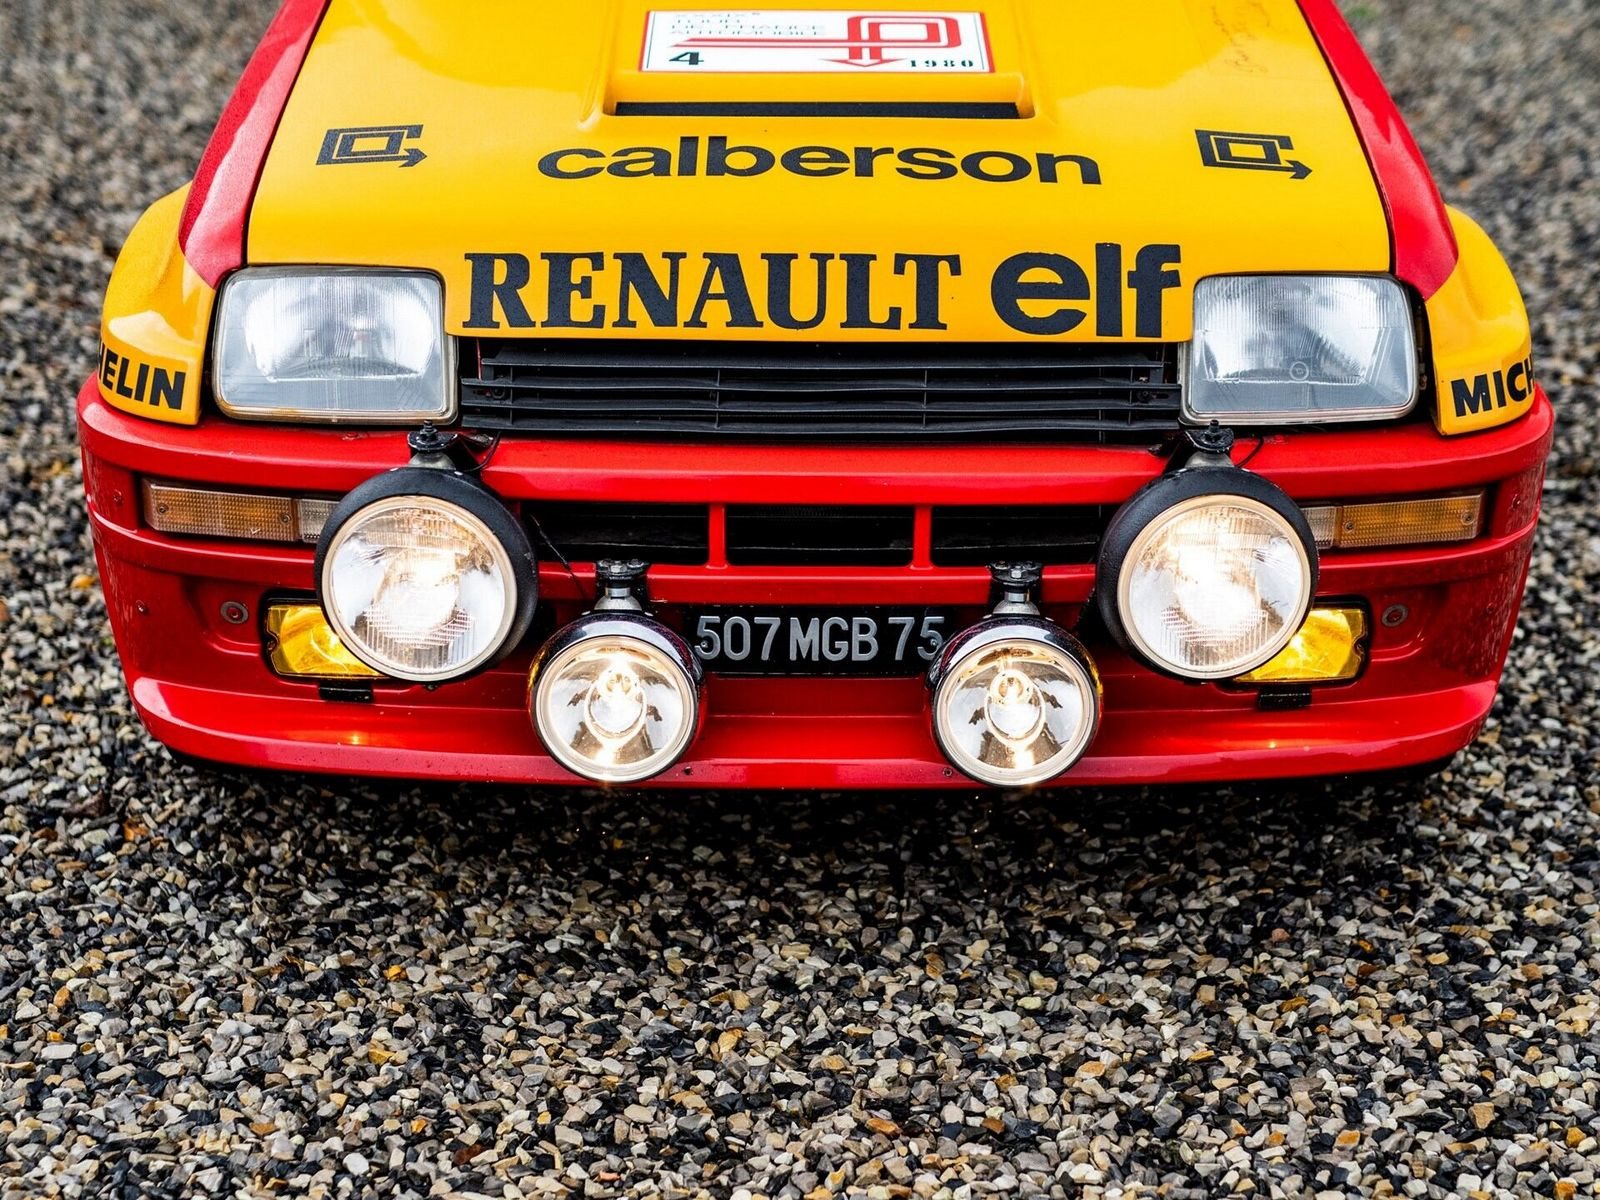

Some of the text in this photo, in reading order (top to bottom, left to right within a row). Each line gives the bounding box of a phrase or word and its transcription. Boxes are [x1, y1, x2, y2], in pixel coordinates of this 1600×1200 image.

[669, 52, 704, 65] 4
[538, 136, 1102, 185] calberson
[463, 252, 961, 330] RENAULT
[991, 243, 1181, 337] elf
[694, 616, 944, 661] 507 MGB 75
